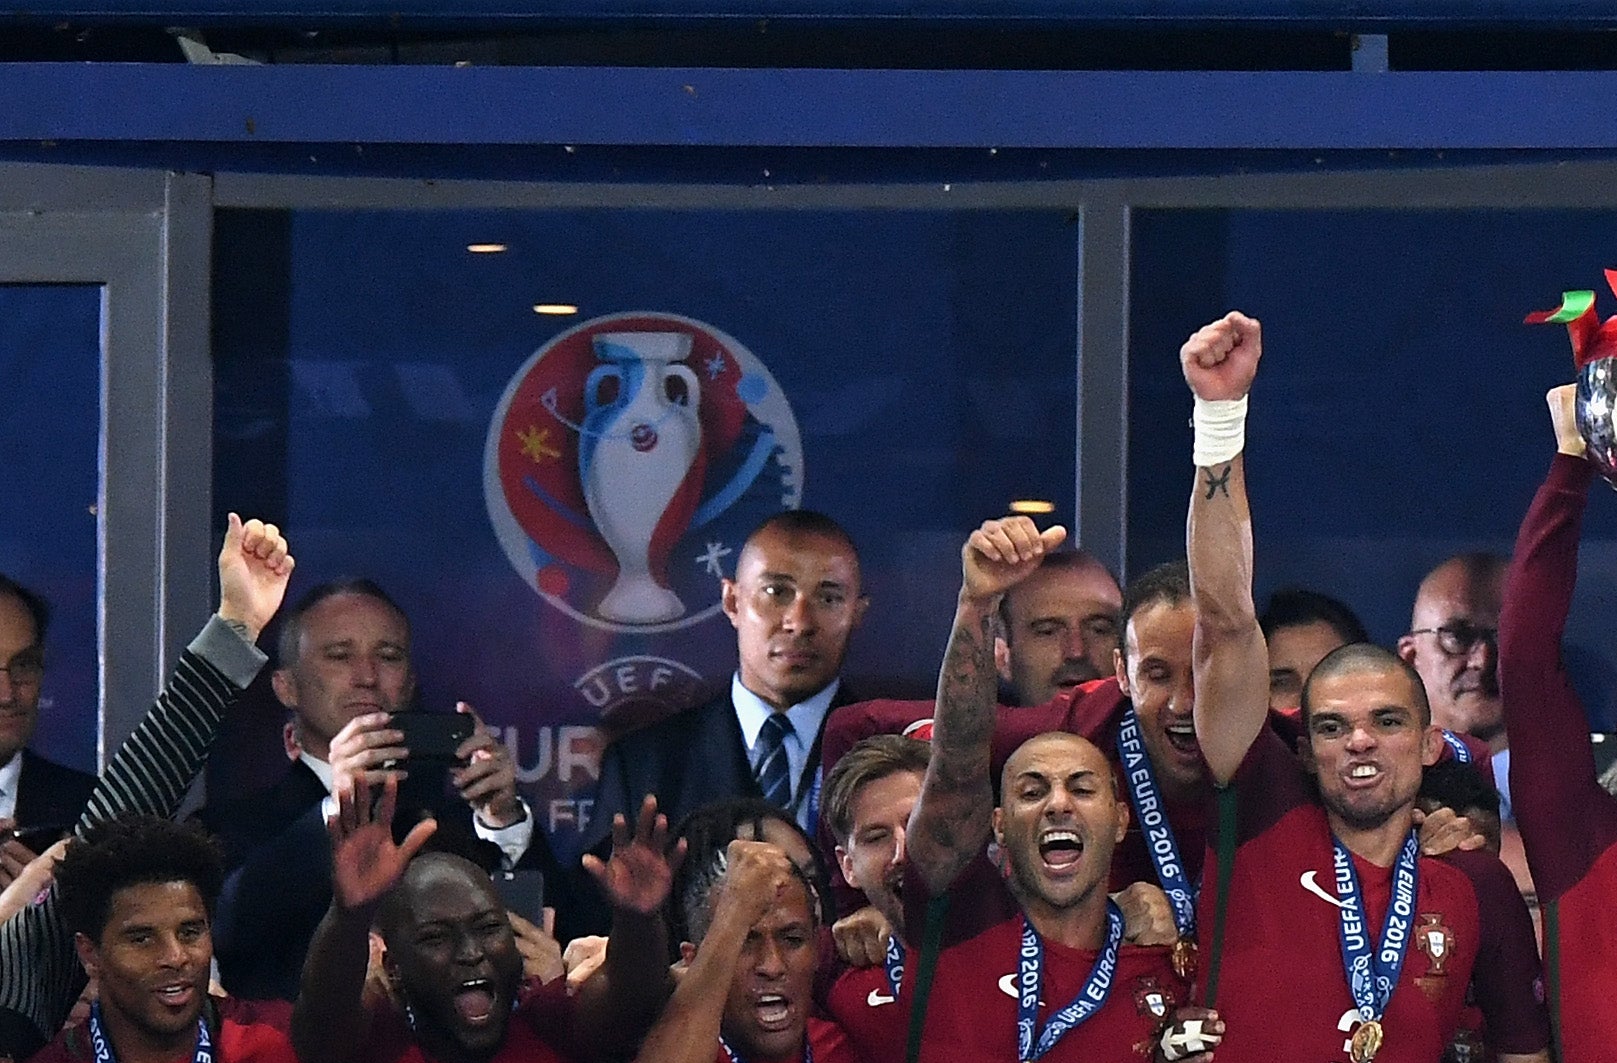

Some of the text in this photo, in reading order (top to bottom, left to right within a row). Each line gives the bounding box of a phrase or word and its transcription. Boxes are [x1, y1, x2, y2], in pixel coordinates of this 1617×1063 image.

[581, 666, 673, 707] UEF
[486, 726, 600, 783] UR
[1131, 767, 1162, 826] EURO
[1149, 827, 1181, 878] 2016
[1334, 847, 1364, 951] UEFA EUR
[1393, 870, 1415, 915] EURO
[1381, 917, 1407, 963] 2016
[1021, 960, 1039, 1008] 2016
[1057, 913, 1122, 1022] UEFA EURO 201
